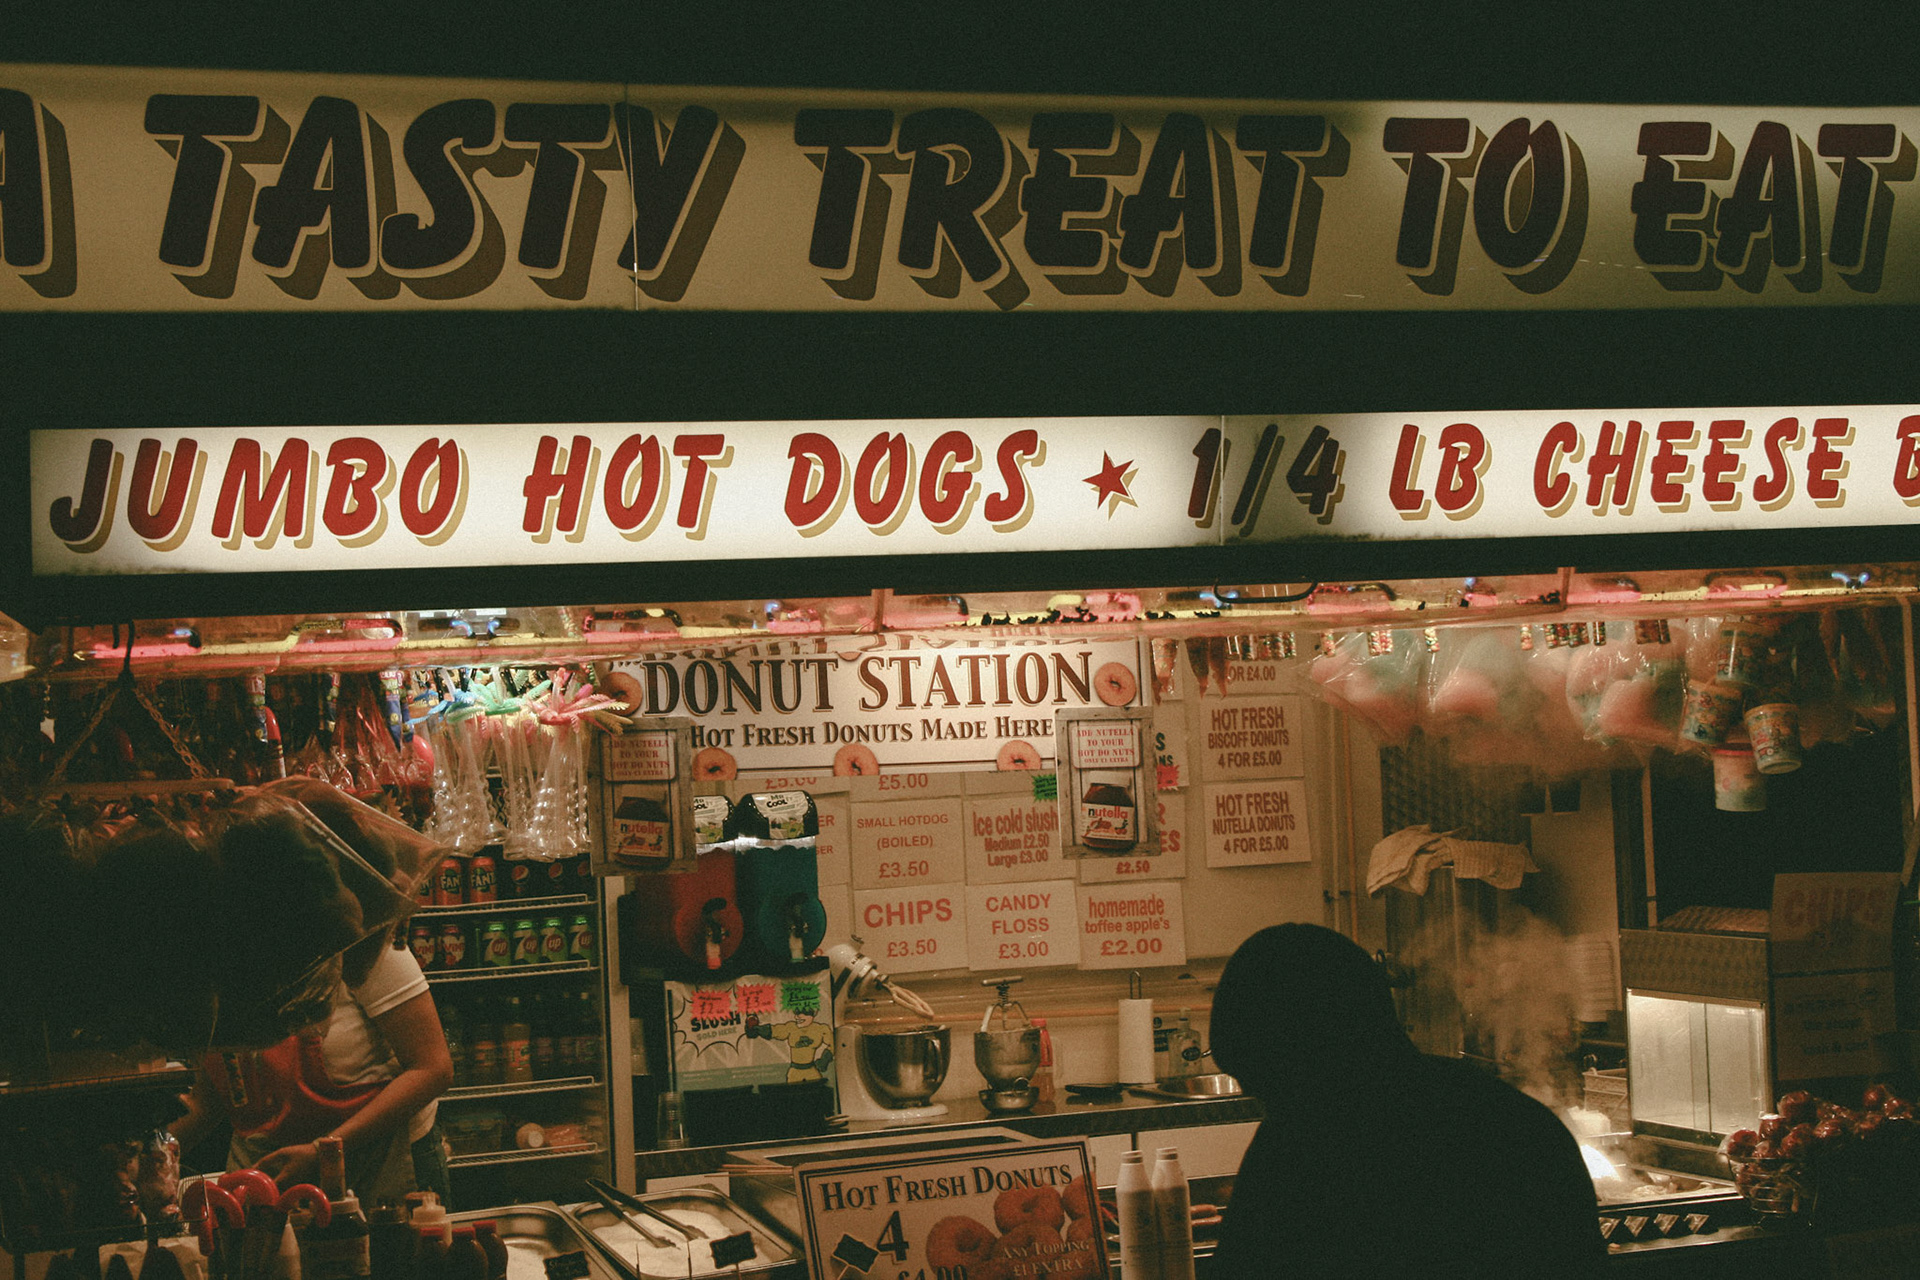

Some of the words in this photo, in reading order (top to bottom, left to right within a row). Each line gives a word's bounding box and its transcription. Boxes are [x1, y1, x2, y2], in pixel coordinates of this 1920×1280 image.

[144, 95, 747, 302] TASTY
[795, 108, 1351, 310] TREAT
[1383, 117, 1589, 296] TO
[1631, 121, 1918, 293] EAT
[1188, 424, 1346, 537] 1/4
[1389, 423, 1492, 521] LB
[1534, 417, 1855, 518] CHEESE
[50, 437, 469, 554] JUMBO
[523, 434, 735, 545] HOT
[784, 429, 1047, 538] DOGS
[1229, 666, 1245, 681] OR
[1247, 666, 1276, 681] £4.00
[640, 657, 839, 717] DONUT
[858, 652, 1092, 711] STATION
[1211, 708, 1239, 731] HOT
[1241, 706, 1284, 729] FRESH
[1096, 728, 1134, 736] NUTELLA
[1208, 731, 1249, 749] BISCOFF
[1250, 729, 1290, 747] DONUTS
[1087, 739, 1098, 747] TO
[1100, 738, 1124, 746] YOUR
[1218, 753, 1226, 769] 4
[1227, 752, 1250, 768] FOR
[1252, 750, 1282, 767] £5.00
[878, 773, 928, 791] £5.00
[1088, 805, 1128, 819] nutella
[1216, 794, 1243, 817] HOT
[1246, 791, 1289, 815] FRESH
[620, 822, 664, 835] nutella
[856, 817, 896, 829] SMALL
[899, 814, 949, 826] HOTDOG
[972, 811, 993, 836] Ice
[995, 807, 1023, 835] cold
[1025, 805, 1059, 832] slush
[1212, 816, 1256, 835] NUTELLA
[1257, 814, 1295, 832] DONUTS
[877, 835, 933, 850] (BOILED)
[984, 836, 1021, 851] Medium
[1023, 832, 1050, 849] £2.50
[1223, 839, 1231, 854] 4
[1233, 837, 1257, 854] FOR
[1259, 835, 1289, 852] £5.00
[987, 853, 1018, 868] Large
[1020, 849, 1048, 864] £3.00
[1116, 860, 1150, 874] £2.50
[878, 860, 929, 879] £3.50
[985, 893, 1051, 913] CANDY
[1088, 894, 1165, 919] homemade
[864, 898, 953, 928] CHIPS
[992, 917, 1050, 935] FLOSS
[1085, 919, 1123, 934] toffee
[1125, 917, 1170, 934] apple's
[887, 938, 937, 957] £3.50
[998, 940, 1049, 960] £3.00
[1100, 938, 1163, 956] £2.00
[876, 1210, 911, 1266] 4
